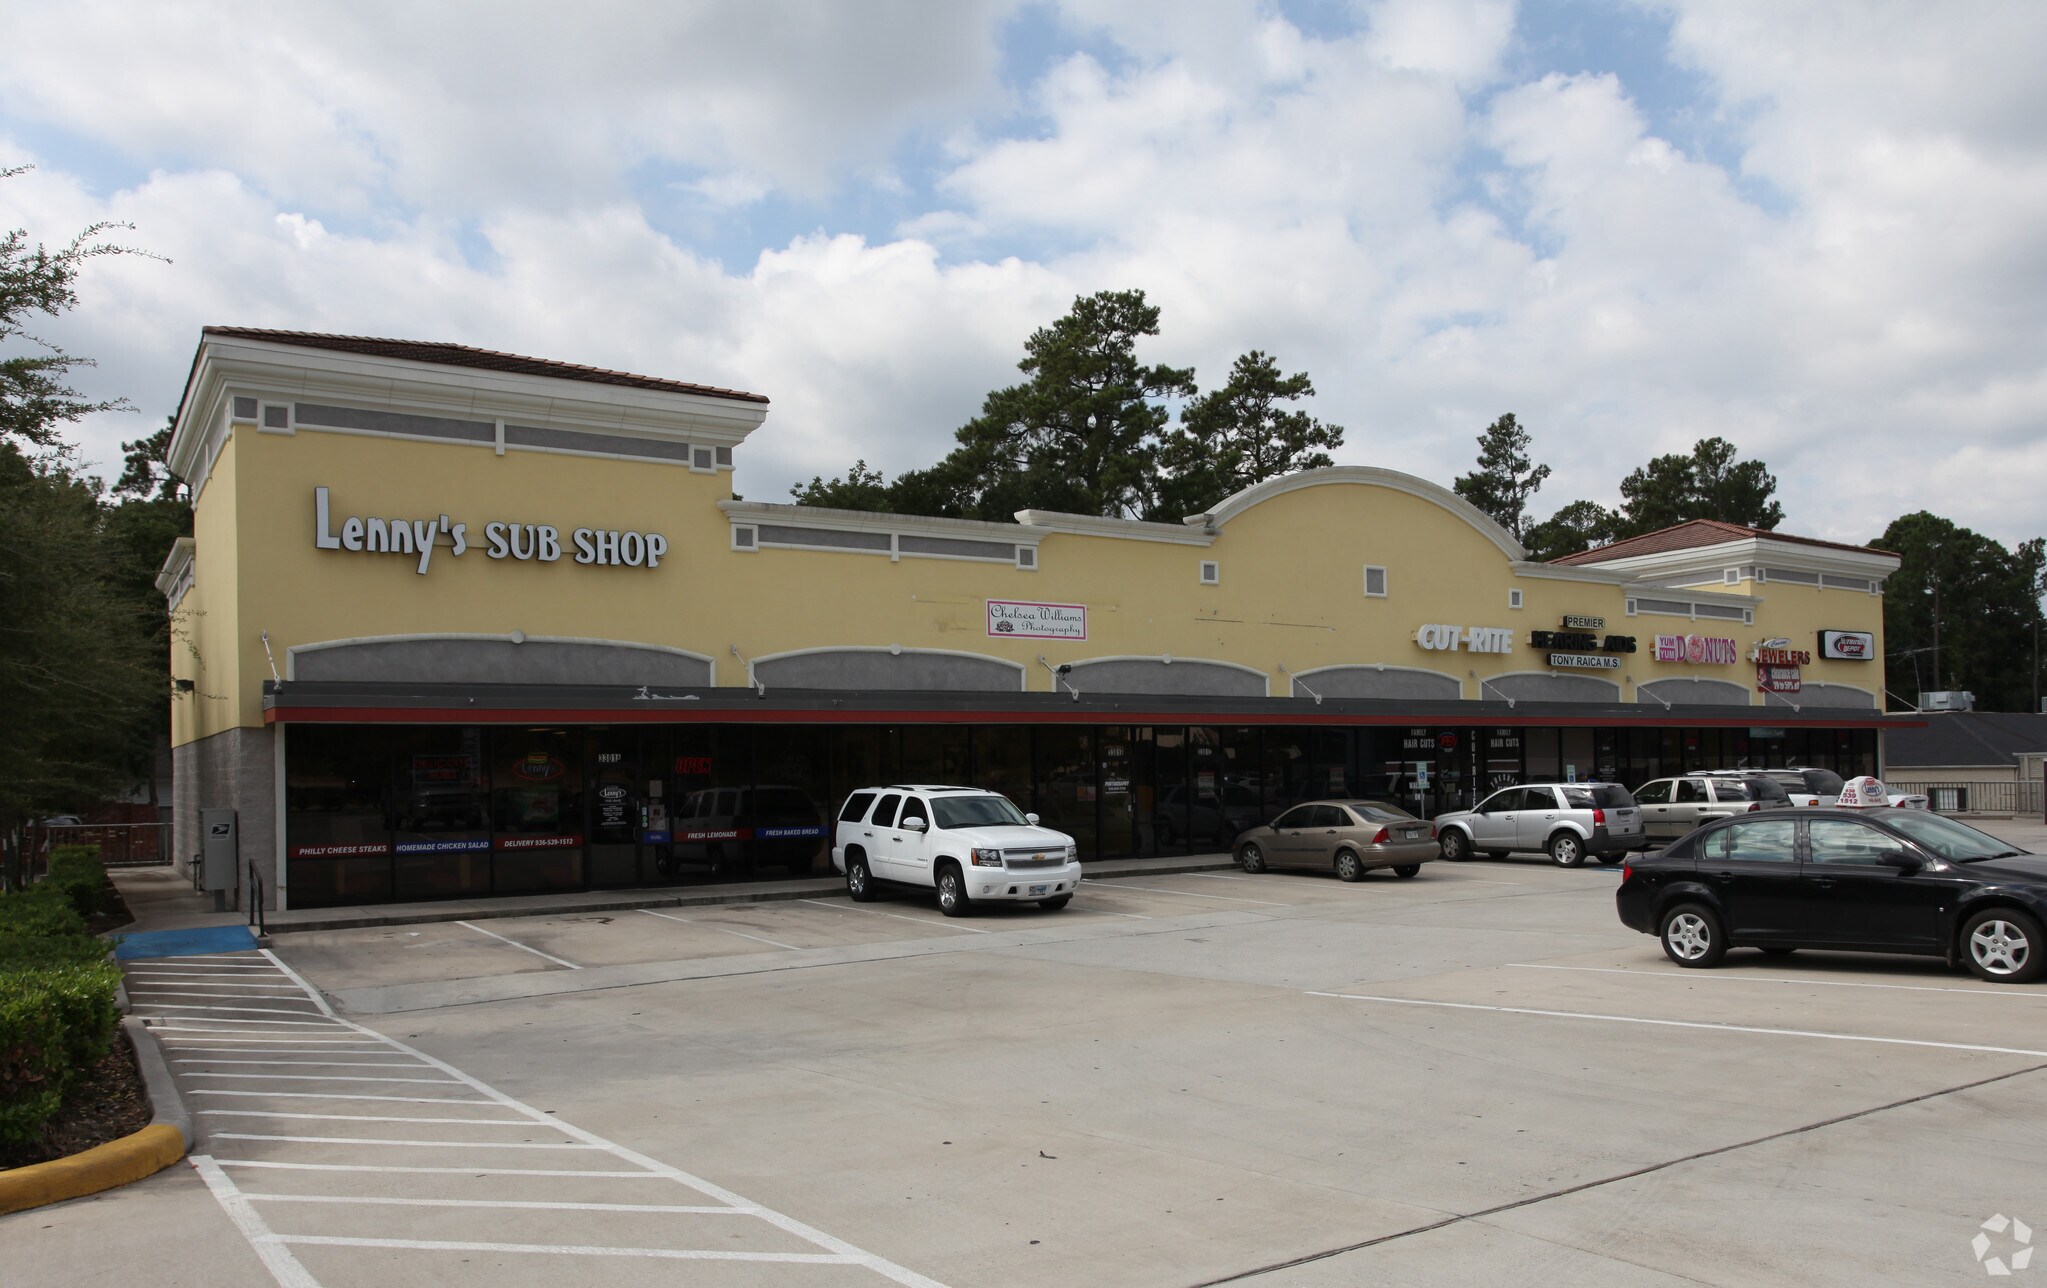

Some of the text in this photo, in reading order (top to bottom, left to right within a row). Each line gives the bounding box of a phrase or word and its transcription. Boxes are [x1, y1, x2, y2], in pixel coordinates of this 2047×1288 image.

[314, 486, 669, 575] Lenny's SUB SHOP
[990, 604, 1082, 623] Chelsea Williams
[1567, 616, 1604, 628] PREMIER
[1021, 621, 1081, 636] Photography
[1417, 623, 1514, 654] CUT-RITE
[1531, 630, 1637, 654] HEARING AIDS
[1659, 637, 1675, 647] YUM
[1659, 649, 1675, 659] YUM
[1756, 648, 1811, 665] JEWELERS
[1552, 654, 1620, 668] TONY RAICA M.S.
[1411, 729, 1427, 737] FAMILY
[1404, 739, 1435, 749] HAIR CUTS
[1490, 738, 1520, 748] HAIR CUTS
[1490, 773, 1519, 789] TUESDAY
[688, 830, 738, 840] FRESH LEMONADE
[765, 828, 819, 837] FRESH BAKED BREAD
[396, 841, 489, 852] HOMEMADE CHICKEN SALAD
[504, 839, 535, 848] DELIVERY
[299, 845, 387, 856] PHILLY CHEESE STEAKS
